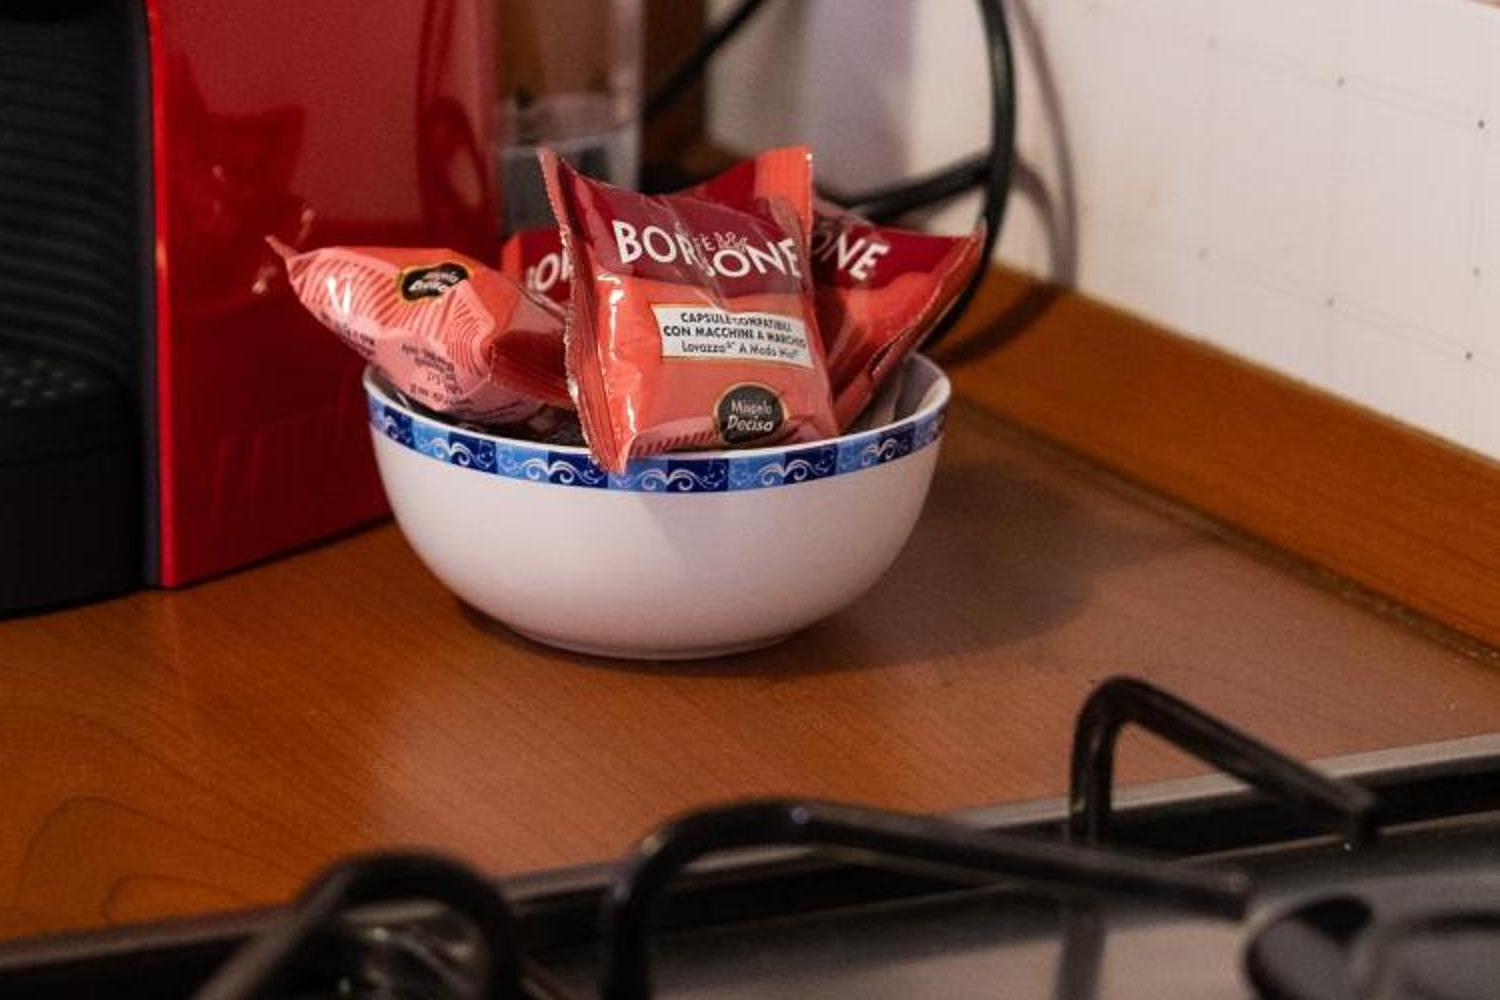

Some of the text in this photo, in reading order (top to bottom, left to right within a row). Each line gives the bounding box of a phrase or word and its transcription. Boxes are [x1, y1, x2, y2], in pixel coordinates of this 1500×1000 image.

[664, 325, 691, 337] CON
[695, 326, 755, 340] MACCHINE
[757, 331, 765, 340] A
[739, 343, 747, 353] A
[750, 344, 777, 357] Modo
